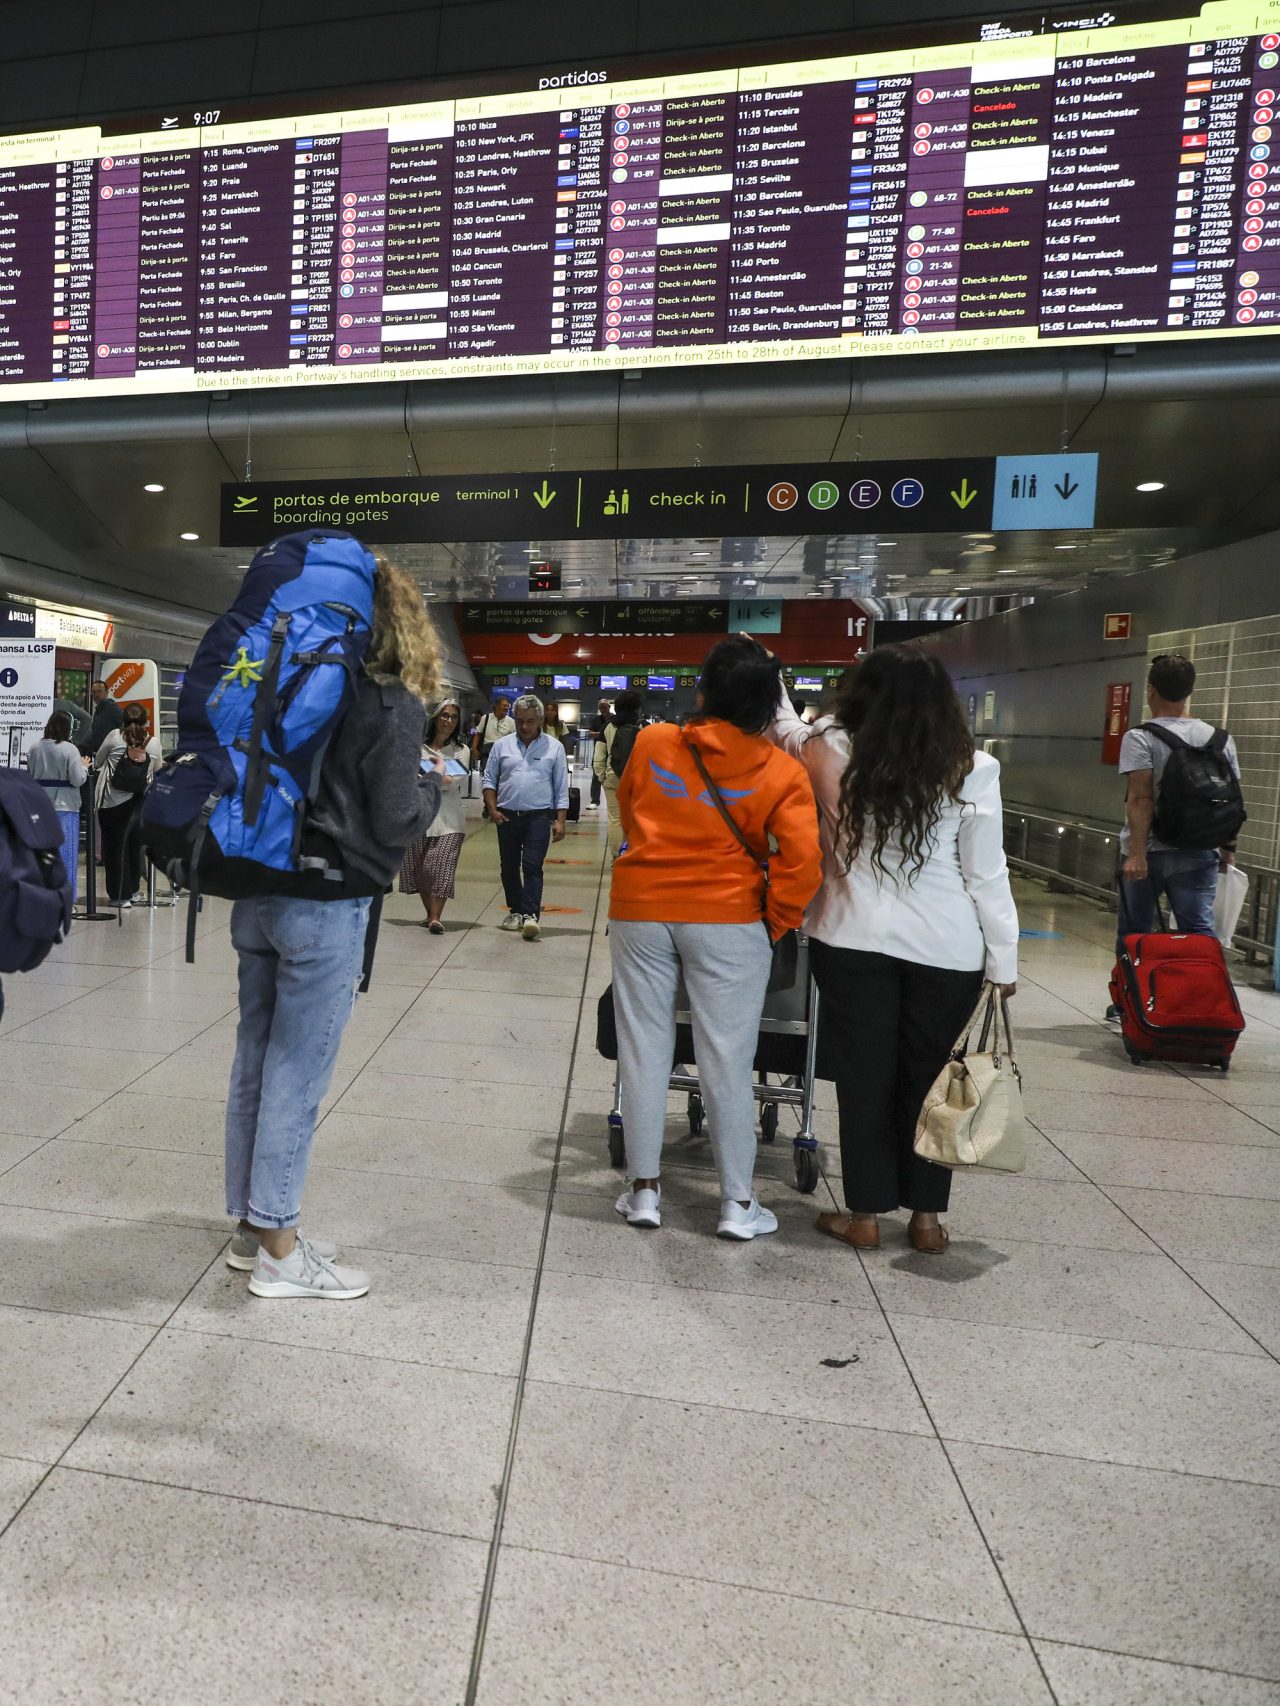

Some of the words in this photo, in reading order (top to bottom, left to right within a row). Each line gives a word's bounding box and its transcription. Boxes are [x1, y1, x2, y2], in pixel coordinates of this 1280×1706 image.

[1052, 19, 1094, 28] VINCI
[1216, 37, 1248, 48] TP1042
[1057, 60, 1083, 70] 14:10
[1086, 56, 1135, 67] Barcelona
[539, 70, 607, 90] partidas
[878, 77, 912, 88] FR2926
[1057, 77, 1082, 87] 14:10
[1085, 75, 1113, 85] Ponta
[1115, 70, 1155, 82] Delgada
[1212, 78, 1251, 89] EJU7605
[974, 85, 1009, 95] Check-in
[1012, 83, 1040, 91] Aberto
[740, 93, 762, 103] 11:10
[765, 90, 803, 100] Bruxelas
[1055, 95, 1080, 105] 14:10
[1083, 92, 1122, 102] Madeira
[973, 100, 1016, 113] Cancelado
[193, 111, 220, 125] 9:07
[739, 110, 761, 119] 11:15
[764, 107, 799, 117] Terceira
[1054, 113, 1079, 123] 14:15
[1082, 109, 1140, 120] Manchester
[457, 123, 477, 132] 10:10
[738, 127, 760, 136] 11:20
[763, 123, 797, 133] Istanbul
[456, 139, 476, 147] 10:10
[497, 135, 517, 143] York,
[518, 133, 534, 141] JFK
[1053, 130, 1078, 140] 14:15
[1080, 129, 1115, 138] Veneza
[204, 149, 218, 157] 9:15
[246, 144, 279, 153] Ciampino
[737, 143, 759, 152] 11:20
[762, 140, 805, 150] Barcelona
[1051, 148, 1076, 158] 14:15
[1079, 145, 1107, 155] Dubai
[456, 154, 475, 163] 10:20
[478, 152, 511, 161] Londres,
[513, 149, 551, 158] Heathrow
[203, 164, 218, 172] 9:20
[222, 162, 247, 170] Luanda
[455, 170, 475, 178] 10:25
[477, 168, 499, 177] Paris,
[501, 167, 517, 175] Orly
[1047, 218, 1072, 227] 14:45
[1074, 215, 1120, 225] Frankfurt
[732, 242, 754, 251] 11:35
[757, 240, 786, 249] Madrid
[731, 259, 753, 267] 11:40
[449, 341, 468, 349] 11:05
[471, 340, 496, 349] Agadir
[197, 377, 216, 388] Due
[220, 377, 229, 386] to
[232, 376, 247, 386] the
[251, 375, 280, 384] strike
[283, 375, 293, 383] in
[296, 370, 347, 383] Portway's
[350, 368, 396, 379] handling
[399, 366, 447, 377] services,
[451, 362, 513, 374] constraints
[517, 362, 539, 372] may
[543, 360, 574, 369] occur
[579, 358, 588, 367] in
[593, 357, 611, 366] the
[614, 354, 670, 366] operation
[674, 351, 703, 362] from
[707, 349, 733, 360] 25th
[737, 349, 748, 358] to
[752, 347, 779, 358] 28th
[783, 345, 795, 356] of
[798, 344, 844, 357] August.
[850, 341, 893, 353] Please
[897, 339, 945, 351] contact
[949, 338, 977, 350] your
[982, 334, 1029, 346] airline.
[274, 494, 324, 510] portas
[330, 492, 349, 505] de
[355, 491, 439, 506] embarque
[456, 489, 510, 500] terminal
[515, 489, 518, 498] 1
[650, 492, 704, 505] check
[711, 491, 725, 504] in
[777, 489, 788, 504] C
[818, 488, 830, 503] D
[859, 486, 871, 502] E
[902, 485, 914, 501] F
[274, 510, 340, 525] boarding
[346, 509, 388, 524] gates
[13, 612, 30, 623] DELTA
[486, 609, 512, 617] portas
[526, 608, 568, 617] embarque
[486, 616, 520, 624] boarding
[522, 616, 543, 624] gates
[28, 645, 54, 653] LGSP
[109, 665, 136, 695] portway
[494, 677, 506, 685] 89
[539, 677, 552, 685] 88
[587, 677, 599, 685] 87
[632, 677, 646, 685] 86
[680, 677, 694, 686] 85
